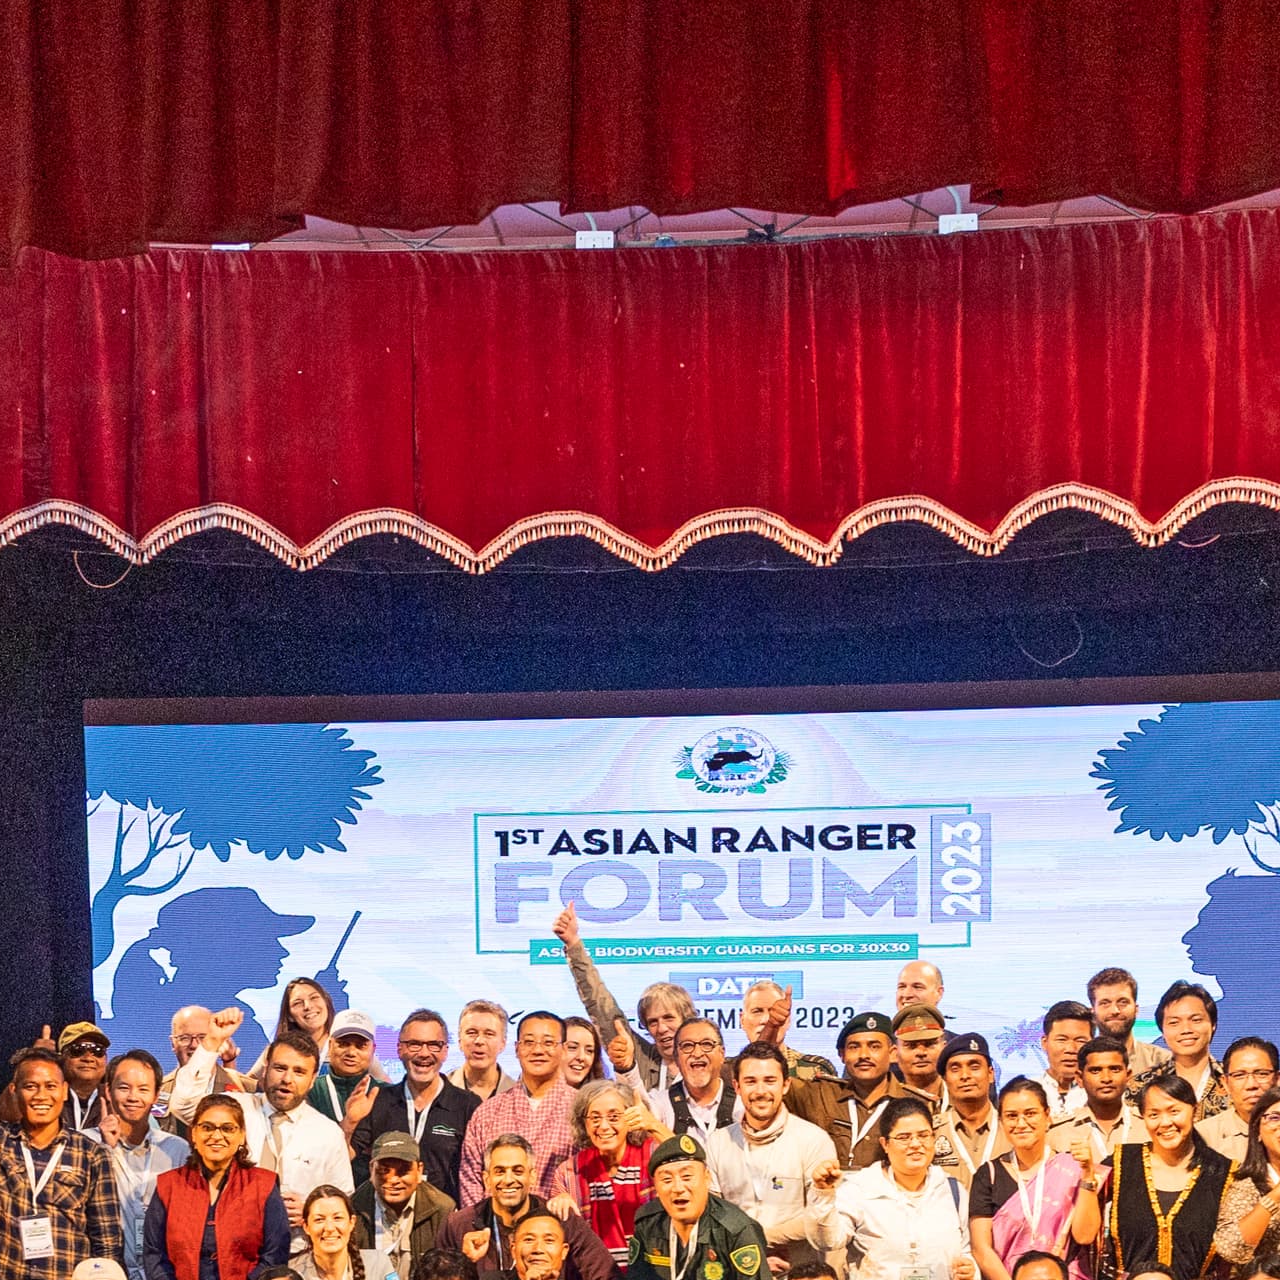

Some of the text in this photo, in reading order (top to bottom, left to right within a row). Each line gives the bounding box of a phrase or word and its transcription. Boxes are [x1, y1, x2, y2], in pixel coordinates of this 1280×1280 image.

[494, 823, 916, 857] 1ST ASIAN RANGER
[941, 820, 982, 915] 2023
[494, 856, 918, 924] FORUM
[595, 944, 710, 957] BIODIVERSITY
[715, 943, 815, 955] GUARDIANS
[819, 942, 854, 954] FOR
[858, 941, 910, 954] 30X30
[698, 976, 776, 995] DAT
